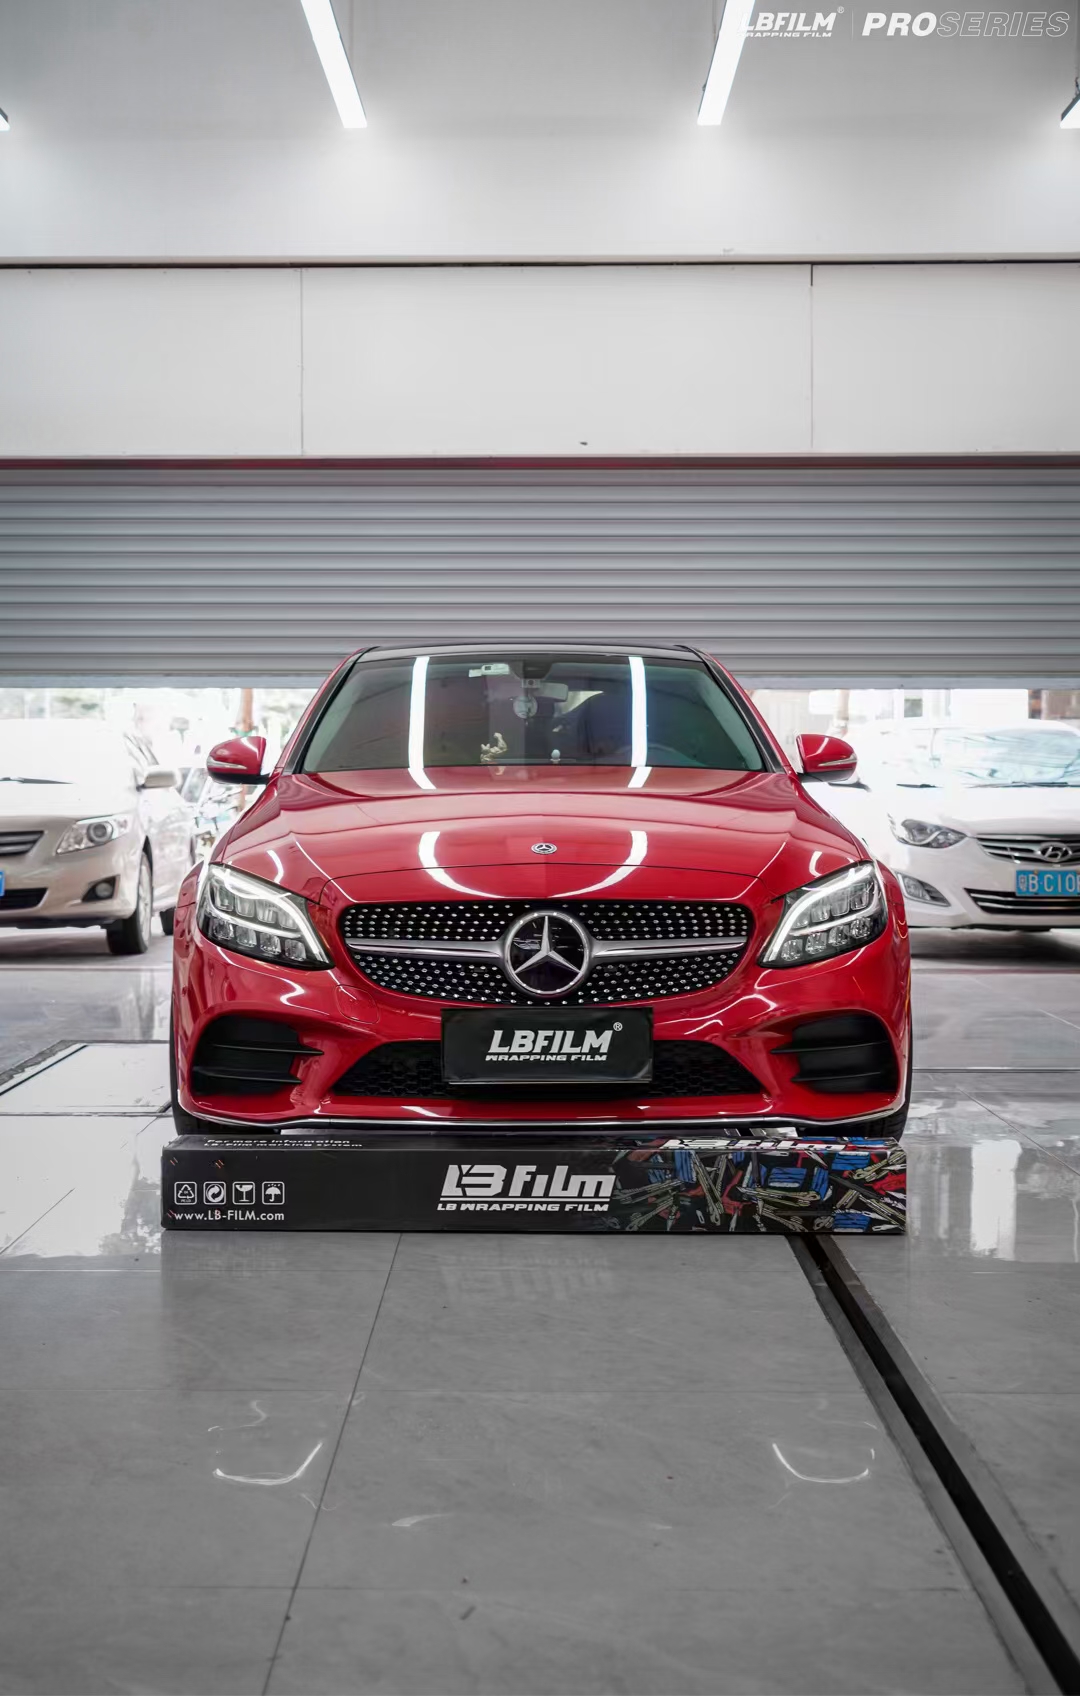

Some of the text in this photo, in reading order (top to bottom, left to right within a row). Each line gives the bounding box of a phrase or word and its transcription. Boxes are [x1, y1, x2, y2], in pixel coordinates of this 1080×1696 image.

[437, 1203, 609, 1212] LB WRAPPING FILM
[174, 1209, 285, 1221] www.LB-FILM.com
